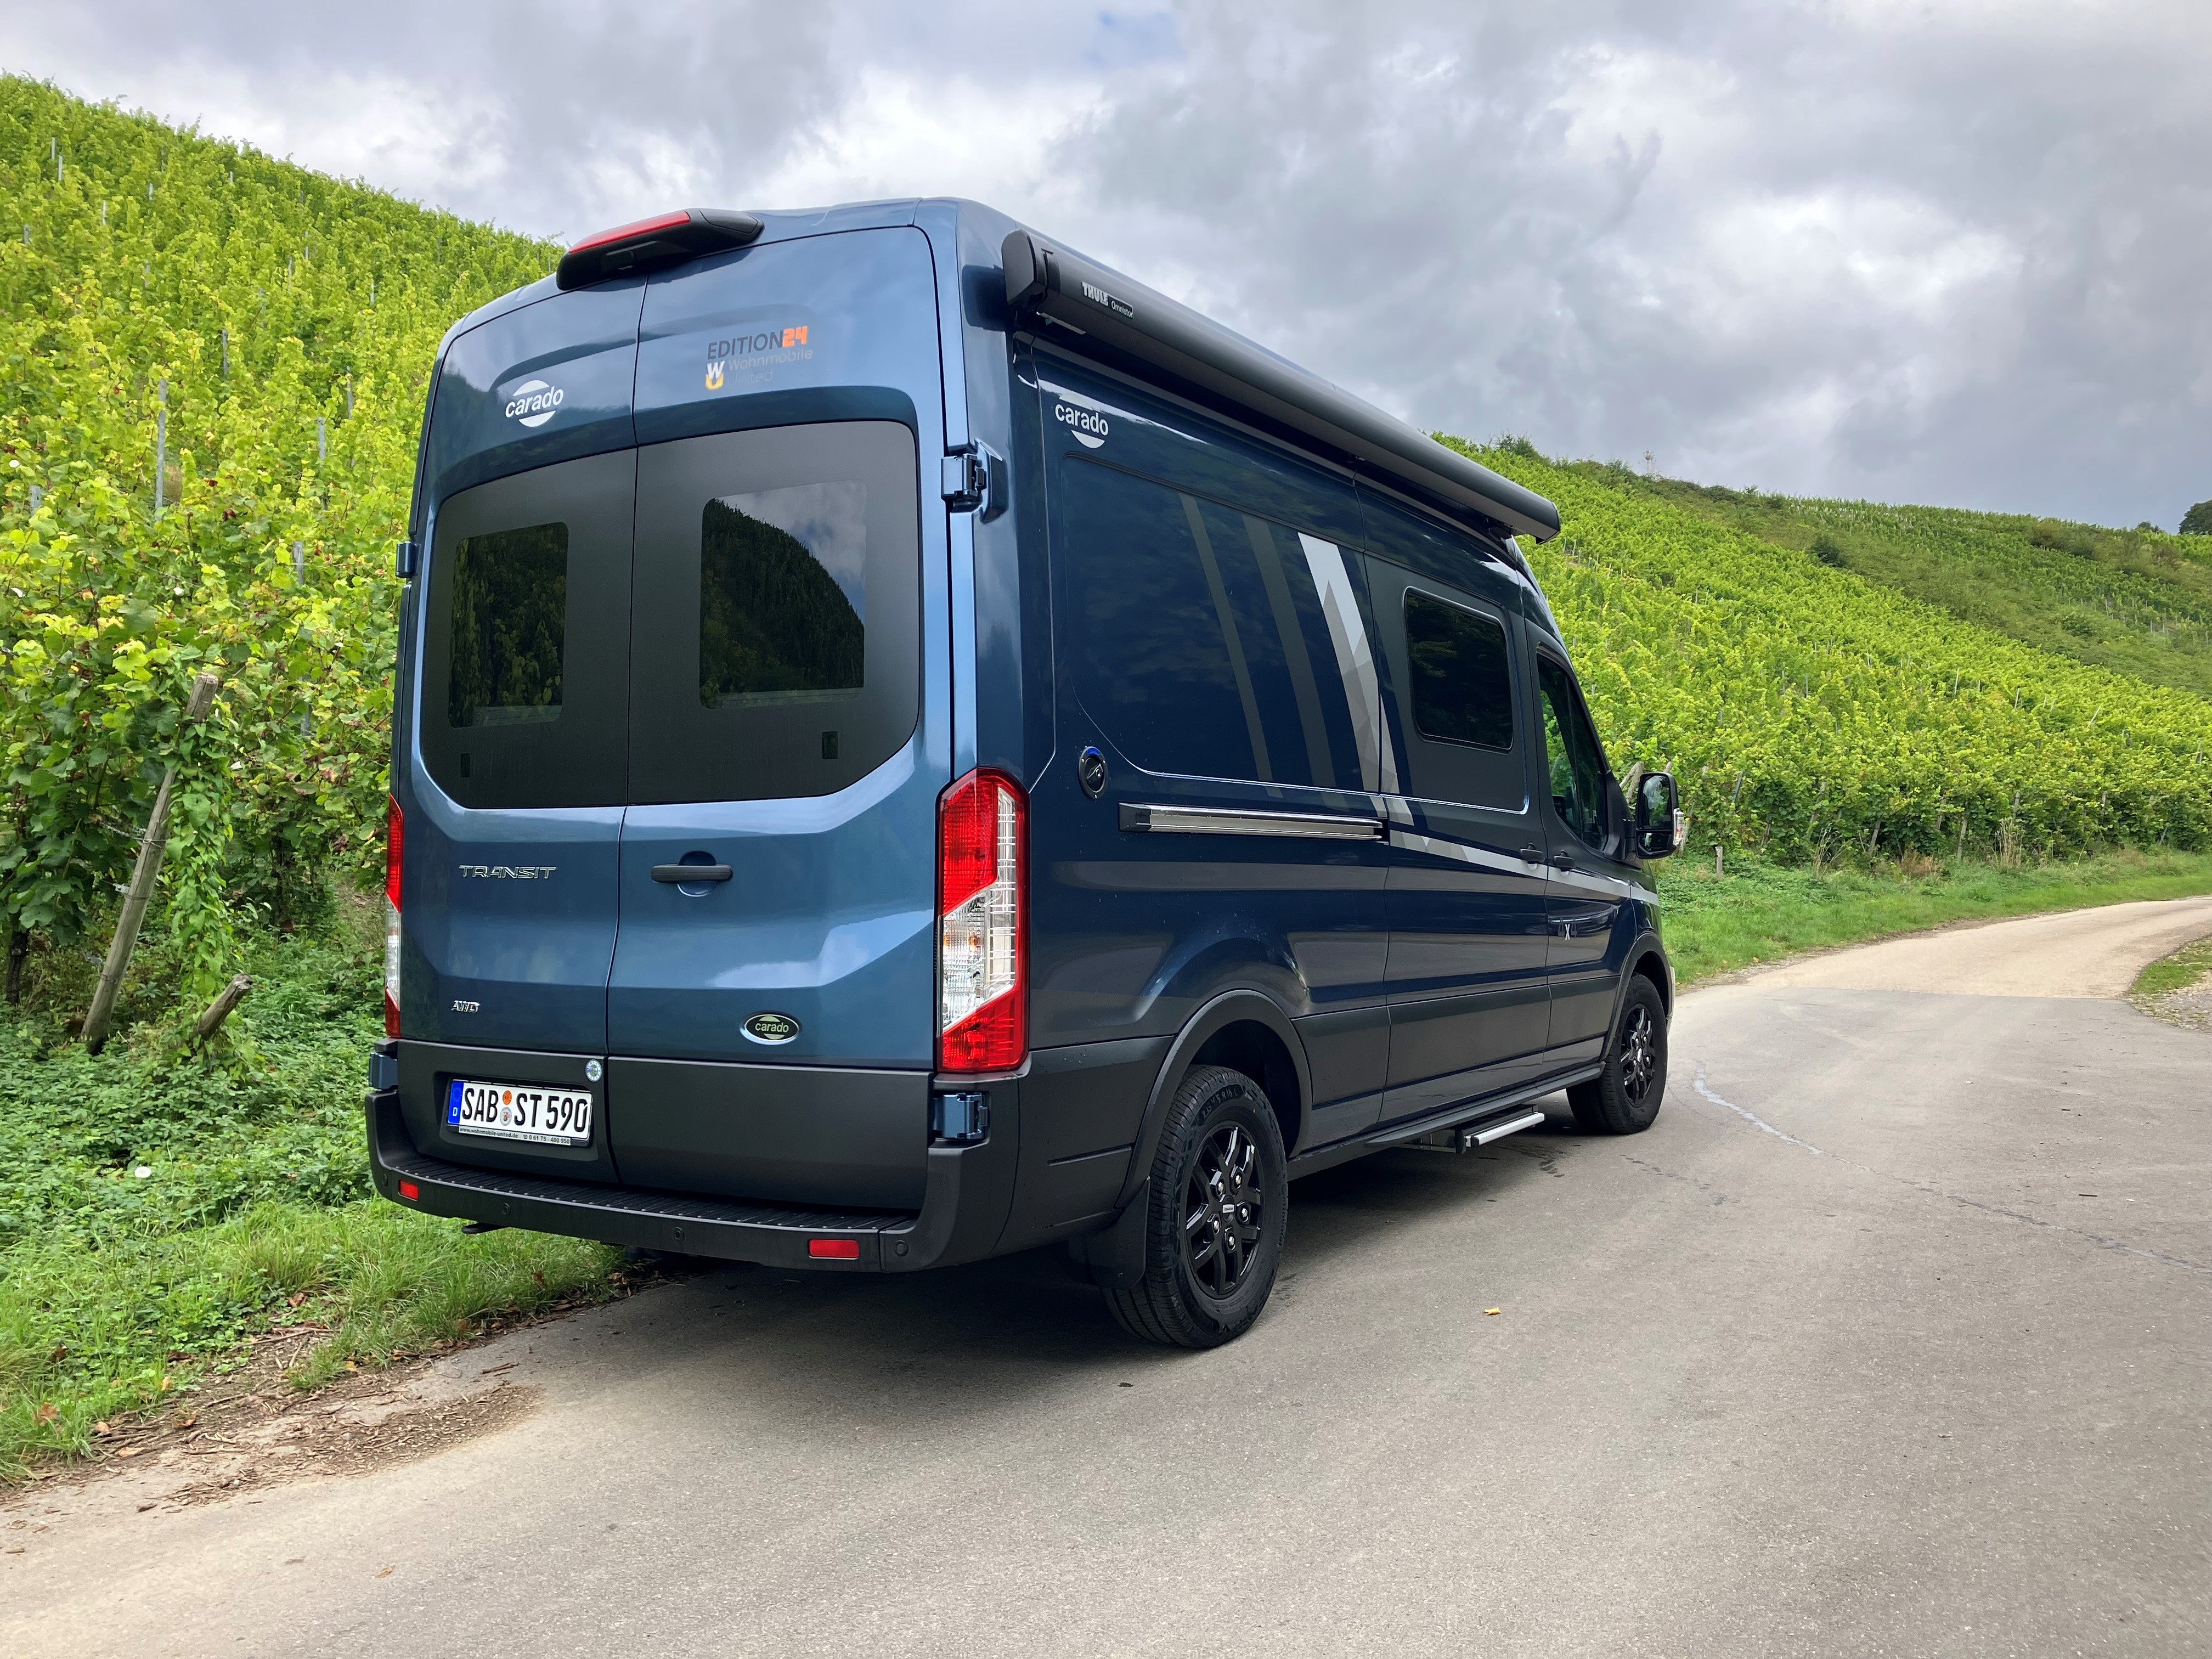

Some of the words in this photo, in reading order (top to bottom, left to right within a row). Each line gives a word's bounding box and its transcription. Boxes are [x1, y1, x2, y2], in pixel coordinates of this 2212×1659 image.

[1081, 281, 1108, 306] THULE
[1111, 301, 1133, 319] Omnistor
[728, 348, 814, 371] Wohnmobile
[505, 386, 564, 418] carado
[1055, 404, 1109, 436] carado
[459, 865, 557, 879] TRANSIT
[450, 1000, 480, 1013] AWD
[755, 1022, 789, 1033] carado
[452, 1107, 458, 1117] D
[462, 1087, 499, 1122] SAB
[514, 1093, 542, 1128] ST
[546, 1096, 588, 1133] 590
